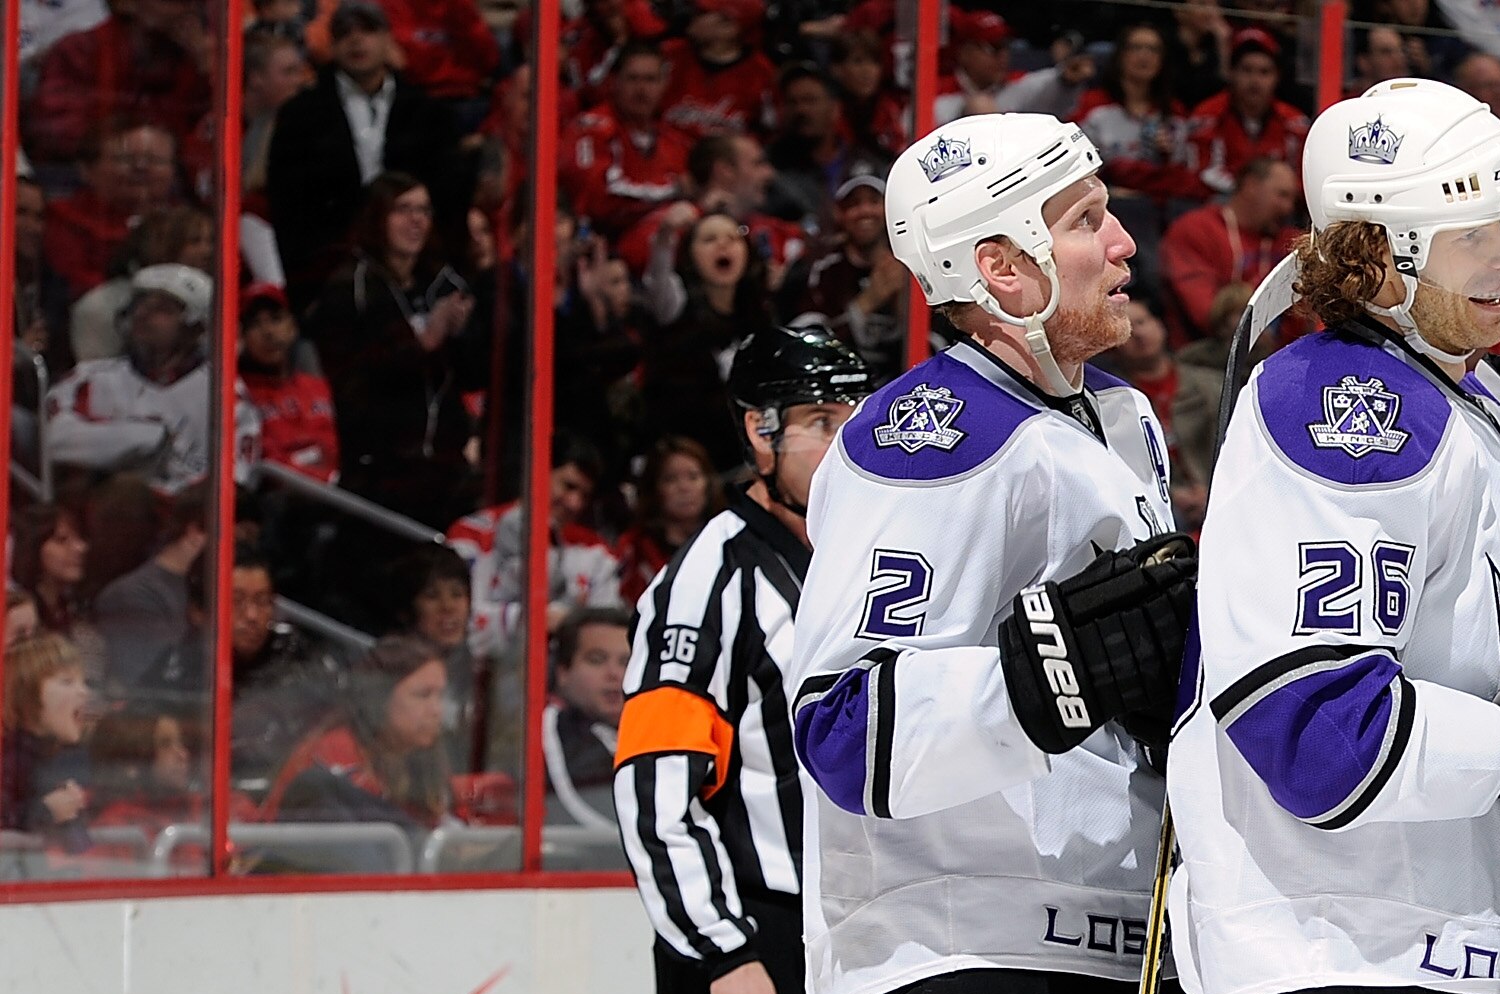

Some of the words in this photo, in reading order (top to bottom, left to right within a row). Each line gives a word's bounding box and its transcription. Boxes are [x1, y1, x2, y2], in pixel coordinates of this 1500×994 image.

[1326, 433, 1390, 446] KINGS
[854, 548, 933, 641] 2
[1291, 540, 1416, 636] 26
[660, 628, 699, 664] 36
